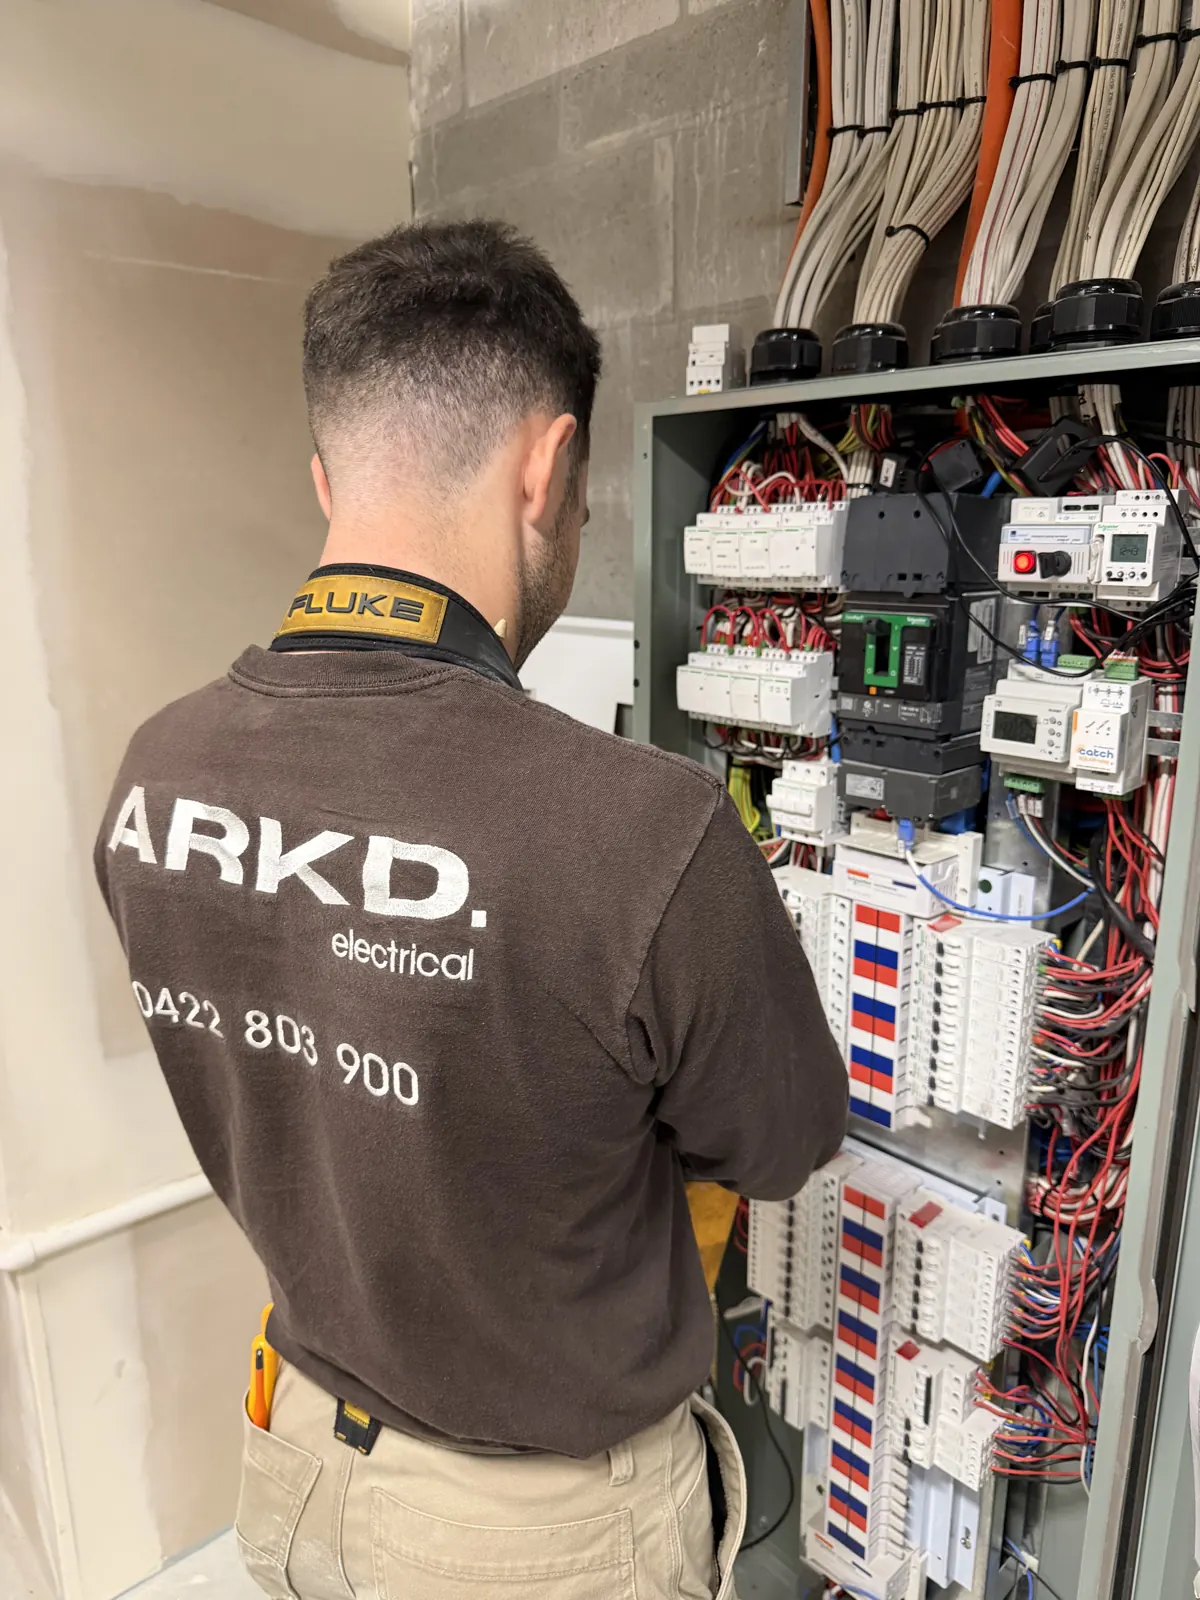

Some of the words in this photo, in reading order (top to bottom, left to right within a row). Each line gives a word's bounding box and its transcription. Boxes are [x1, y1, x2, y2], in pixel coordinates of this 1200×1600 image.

[288, 592, 425, 623] FLUKE
[1079, 748, 1114, 759] catch
[107, 782, 487, 928] ARKD.
[331, 929, 474, 981] electrical
[131, 980, 225, 1039] 0422
[244, 1009, 318, 1067] 803
[336, 1042, 420, 1107] 900
